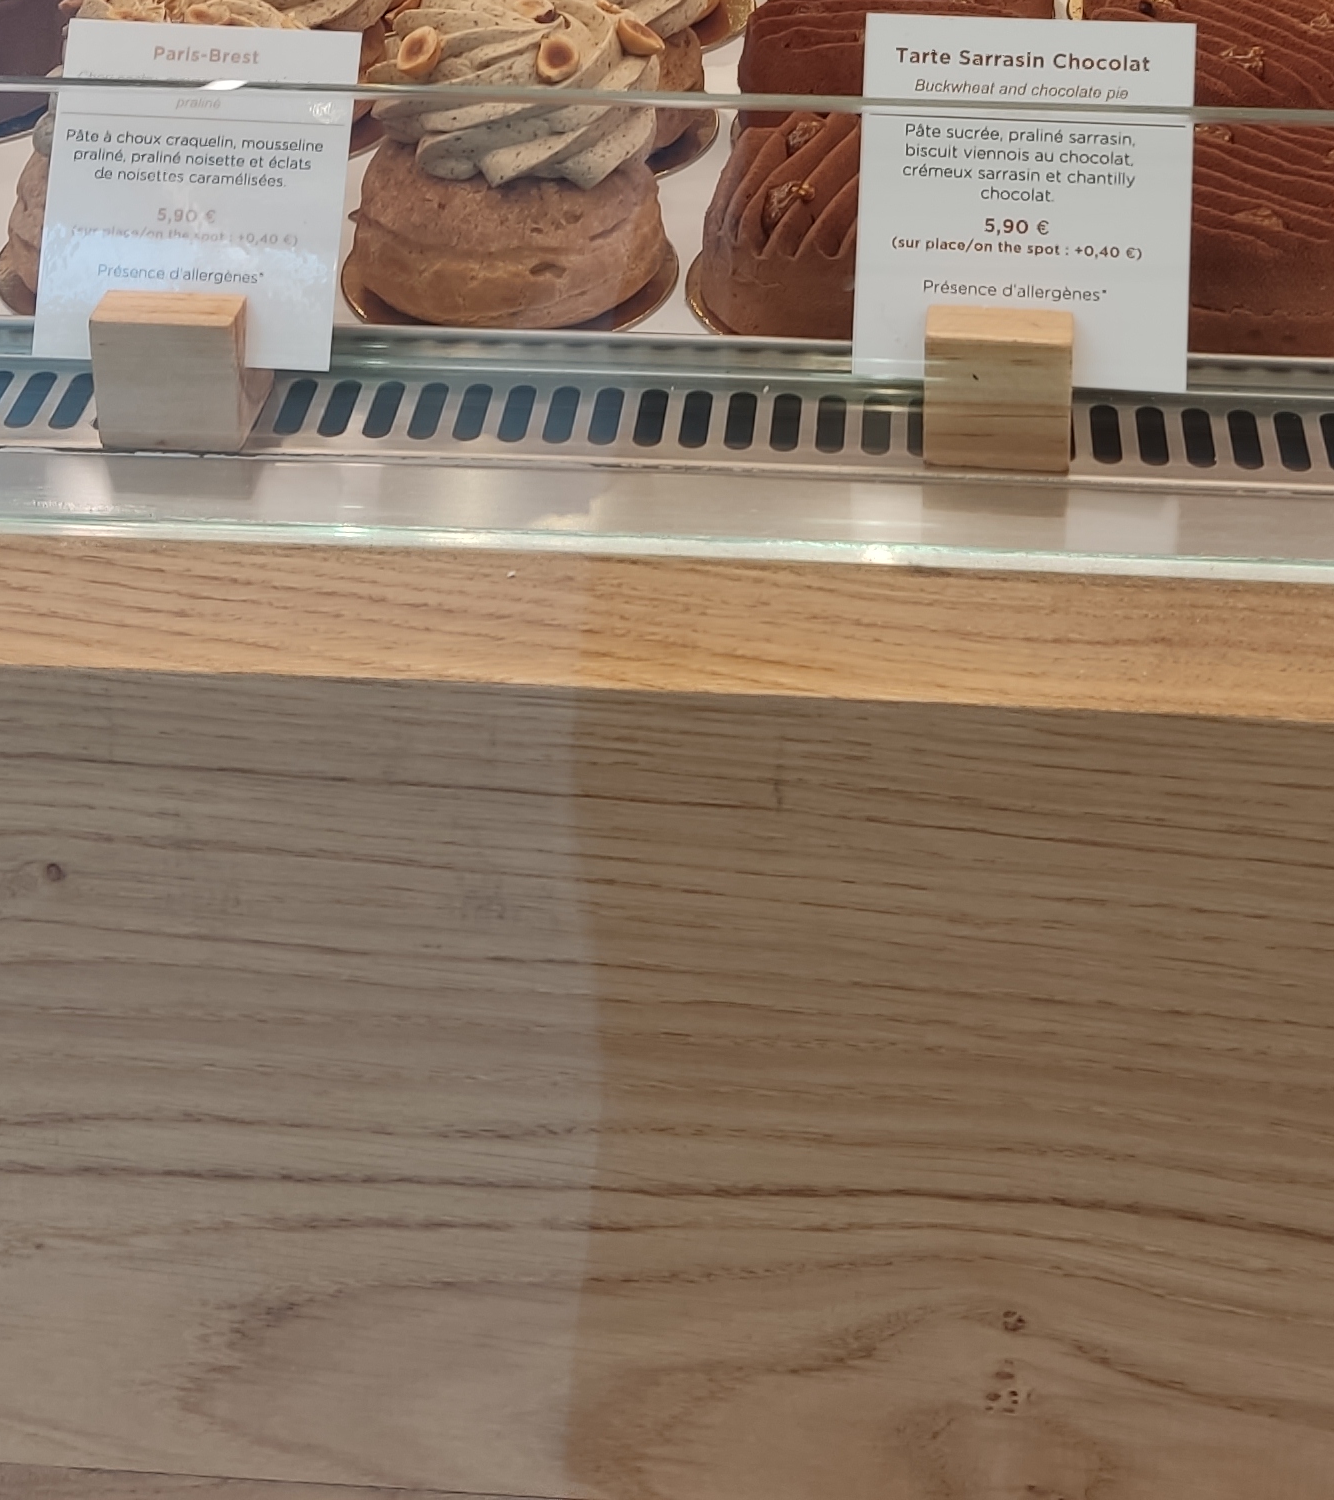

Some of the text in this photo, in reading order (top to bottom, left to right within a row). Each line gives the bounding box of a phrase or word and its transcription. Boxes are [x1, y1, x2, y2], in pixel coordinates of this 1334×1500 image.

[154, 46, 259, 65] Paris-Brest
[896, 48, 1150, 72] Tarte Sarrasin Chocolat
[915, 79, 1128, 102] Buckwheat and chocolate pie
[175, 97, 221, 110] praliné
[66, 129, 323, 152] Pâte à choux craquelin, mousseline
[905, 123, 1136, 148] Pâte sucrée, praliné sarrasin,
[74, 149, 311, 170] praliné, praliné noisette et éclats
[905, 143, 1133, 167] biscuit viennois au chocolat,
[94, 167, 286, 187] de noisettes caramélisées.
[903, 164, 1135, 188] crémeux sarrasin et chantilly
[980, 187, 1054, 202] chocolat.
[157, 208, 216, 224] 5,90 €
[984, 218, 1049, 236] 5,90 €
[892, 236, 921, 250] (sur
[925, 237, 993, 253] place/on
[998, 241, 1021, 252] the
[1027, 242, 1059, 256] spot
[1075, 245, 1119, 259] +0,40
[1125, 247, 1142, 260] €)
[98, 263, 164, 280] Présence
[924, 280, 997, 296] Présence
